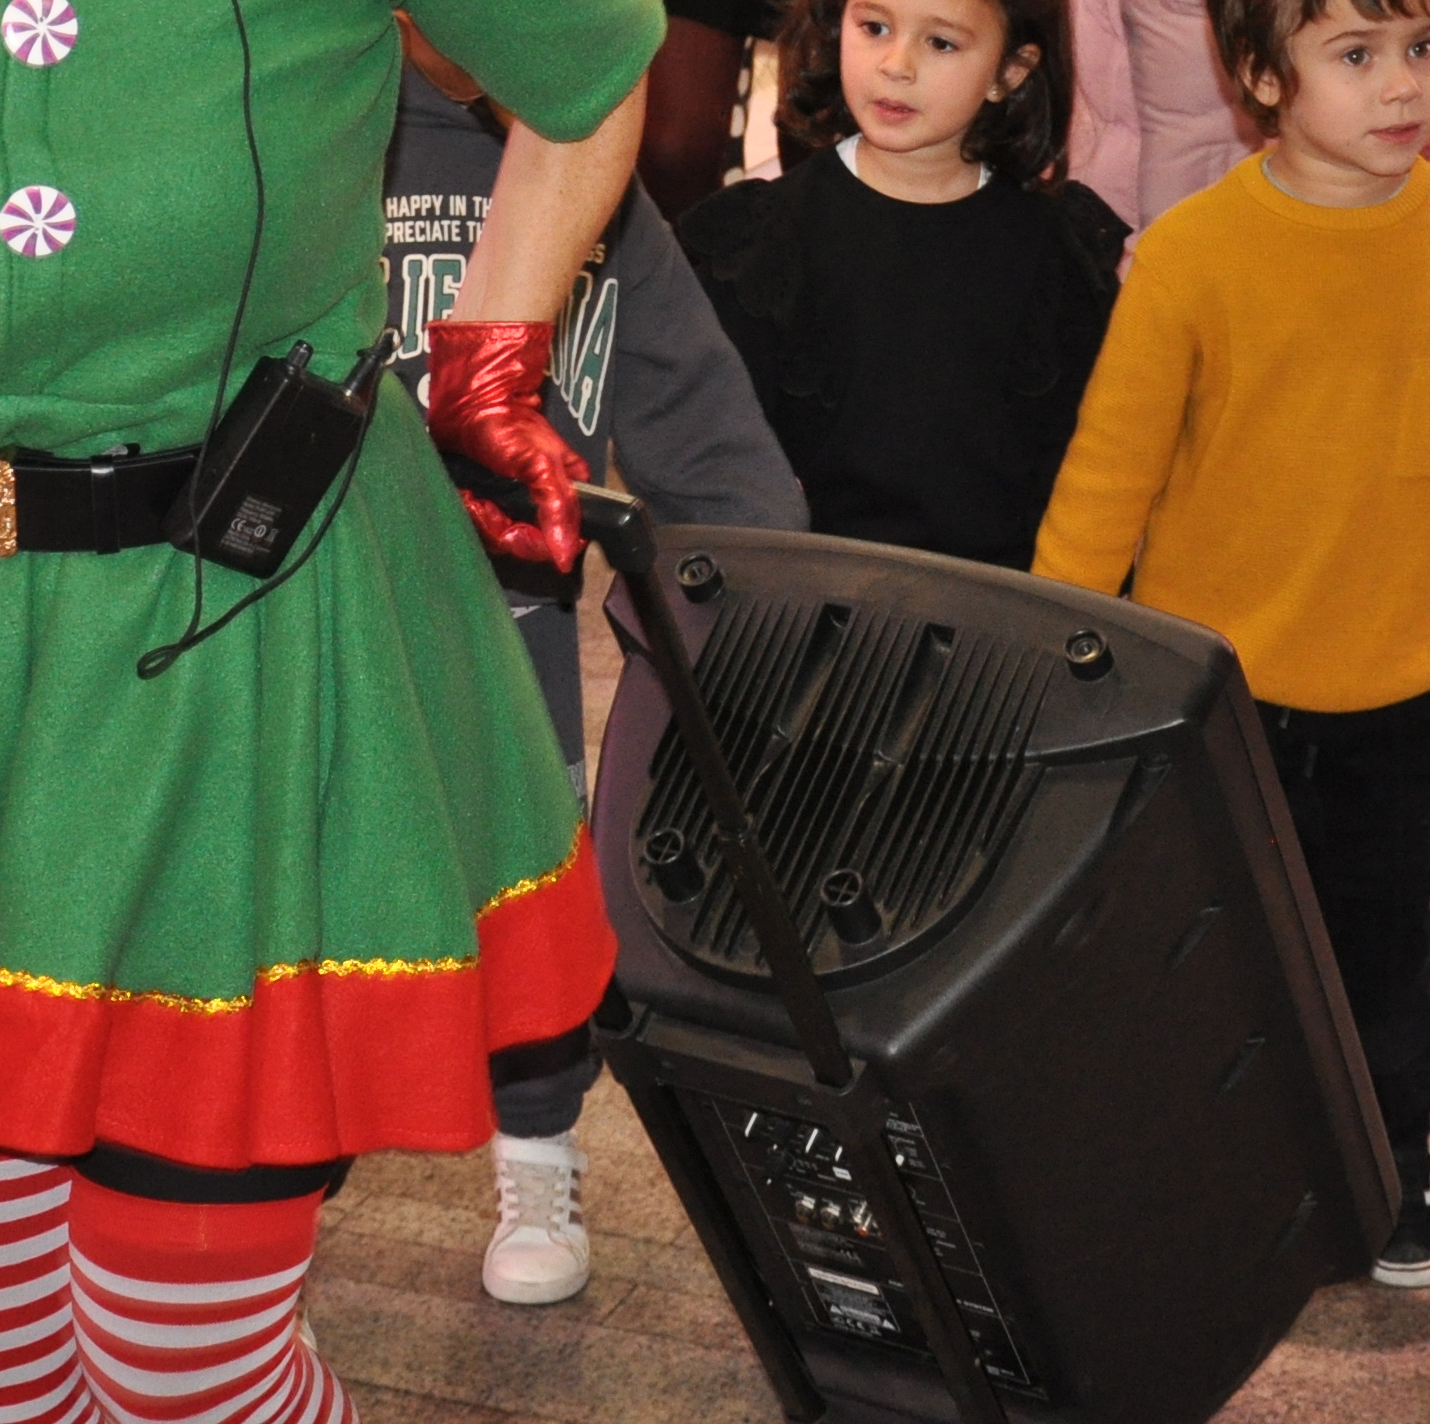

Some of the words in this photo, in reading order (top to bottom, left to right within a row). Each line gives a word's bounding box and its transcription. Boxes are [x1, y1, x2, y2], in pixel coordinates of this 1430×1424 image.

[386, 194, 444, 219] HAPPY
[449, 194, 467, 217] IN
[472, 196, 493, 220] TH
[384, 219, 462, 244] PRECIATE
[466, 221, 484, 244] TH
